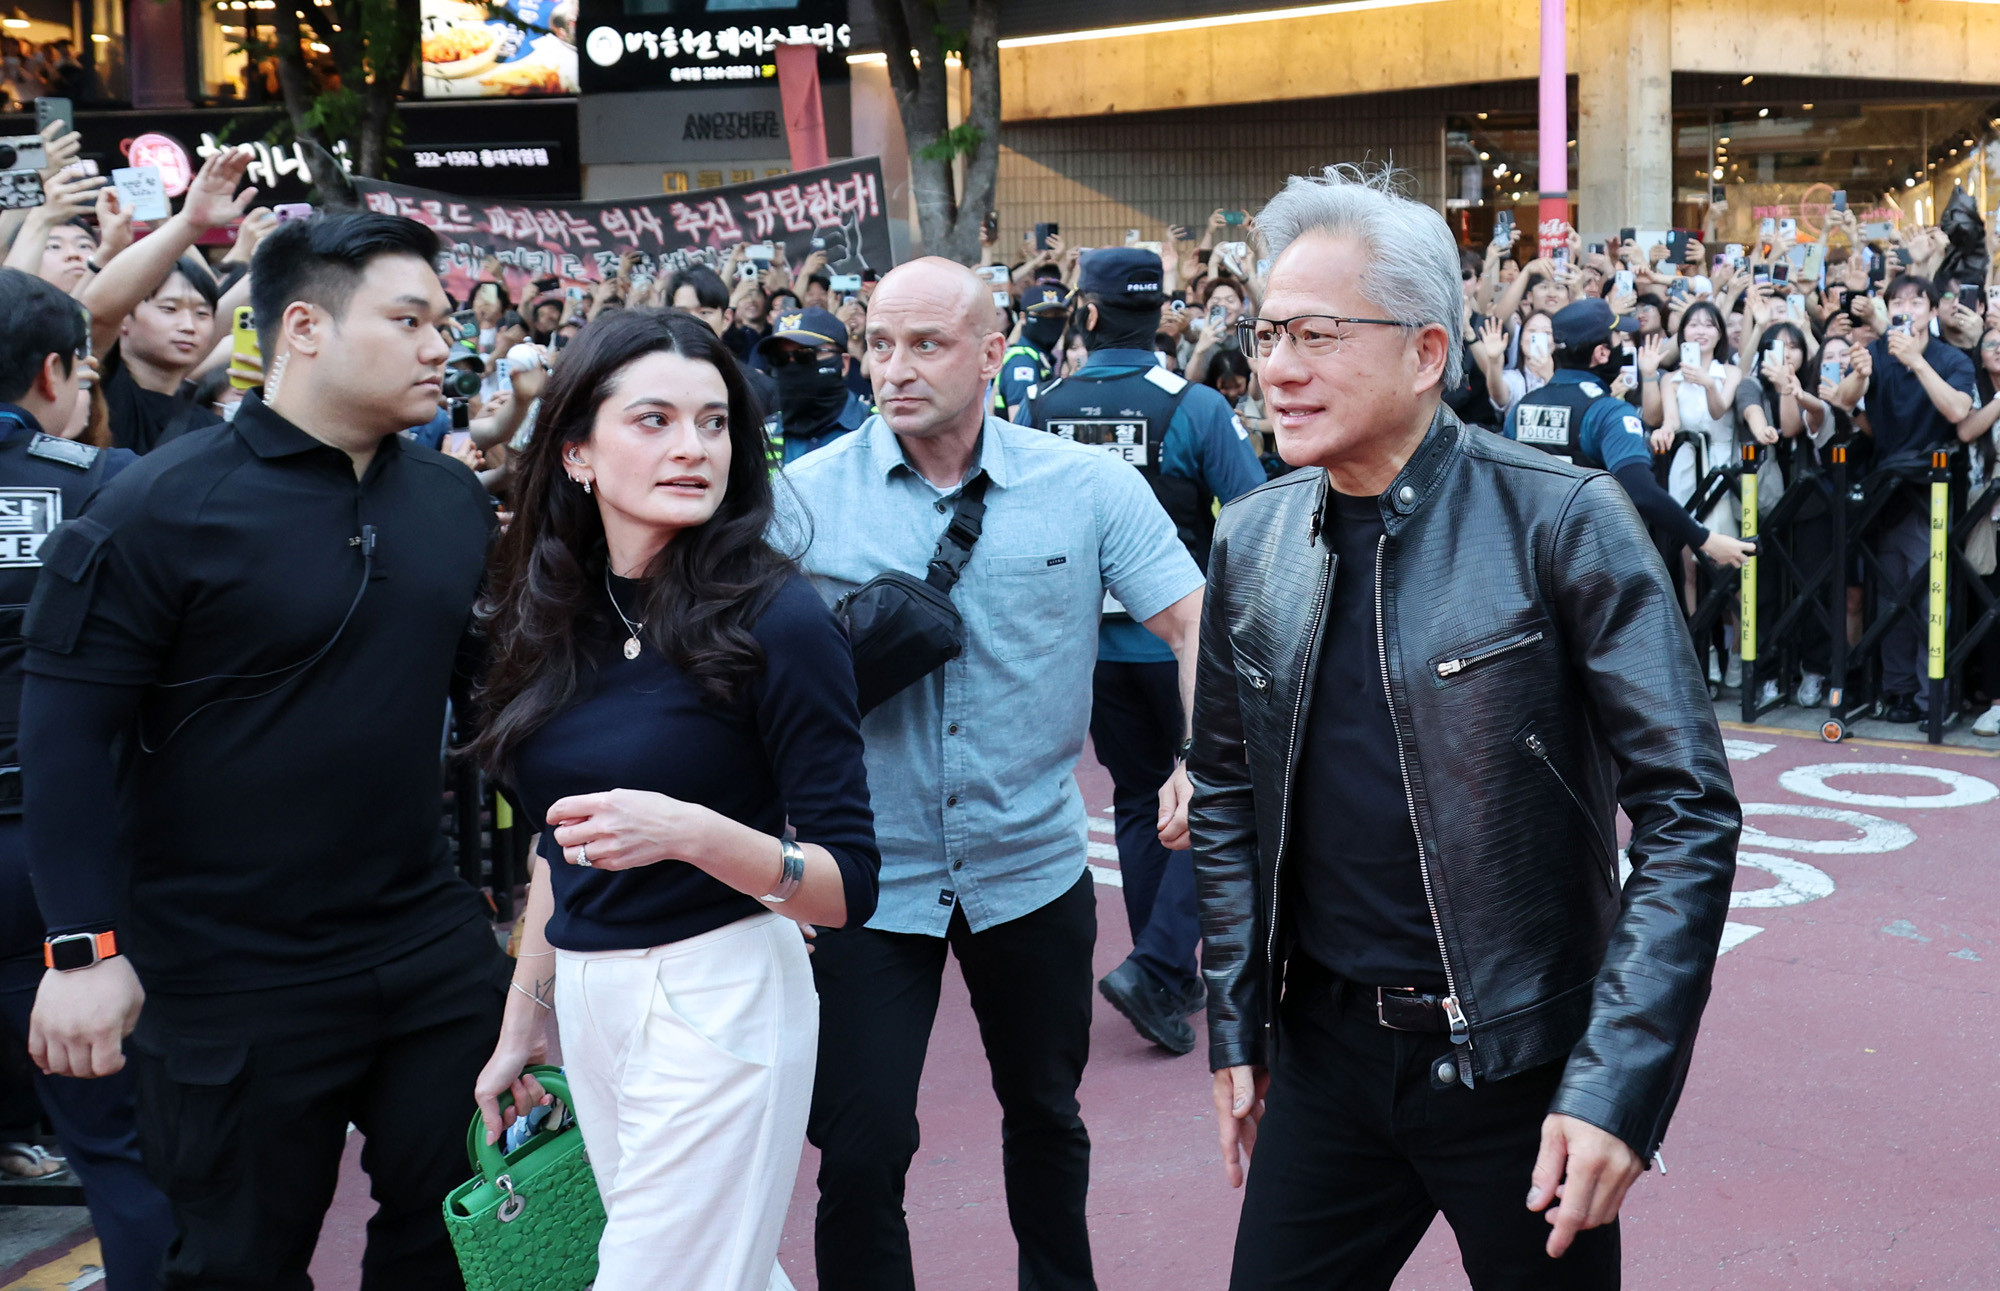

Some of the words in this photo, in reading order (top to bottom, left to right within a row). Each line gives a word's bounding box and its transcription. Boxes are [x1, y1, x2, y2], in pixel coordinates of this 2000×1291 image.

[685, 111, 778, 127] ANOTHER
[682, 123, 780, 140] AWESOME
[483, 206, 601, 247] 파괴하는
[601, 206, 664, 247] 역사
[669, 197, 743, 243] 추진
[742, 172, 880, 238] 규탄한다!
[1126, 283, 1158, 291] POLICE
[1929, 518, 1944, 658] 질서유지선
